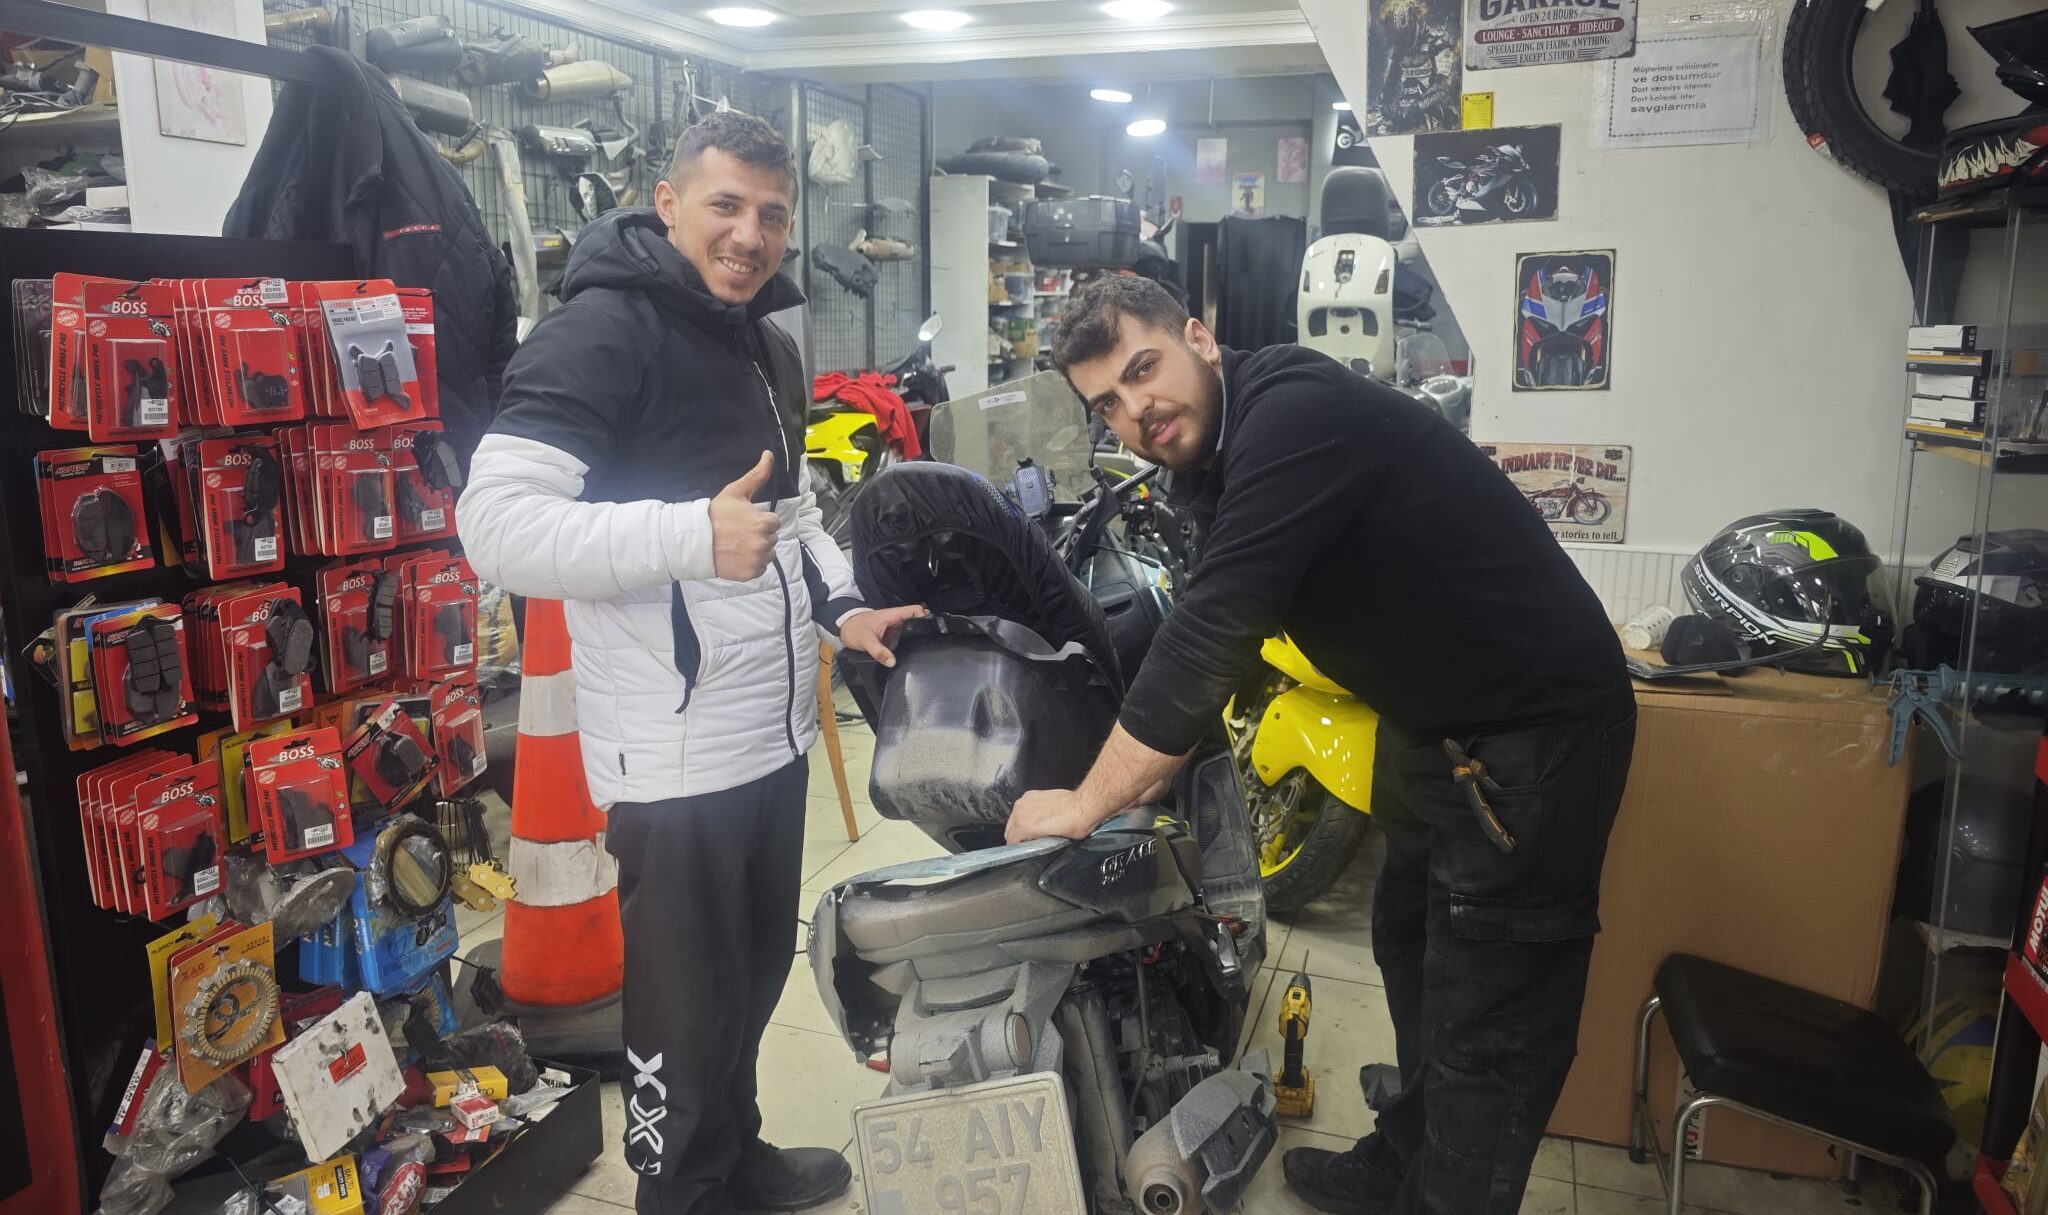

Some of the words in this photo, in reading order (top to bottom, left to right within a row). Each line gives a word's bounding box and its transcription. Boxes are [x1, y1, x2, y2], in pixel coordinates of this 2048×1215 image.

[1519, 13, 1540, 24] OPEN
[1541, 12, 1551, 21] 24
[1552, 10, 1579, 21] HOURS
[1482, 29, 1515, 42] LOUNGE
[1521, 24, 1571, 39] SANCTUARY
[1578, 20, 1616, 34] HIDEOUT
[1487, 41, 1535, 55] SPECIALIZING
[1536, 41, 1545, 51] IN
[1546, 38, 1570, 50] FIXING
[1572, 35, 1610, 48] ANYTHING
[1519, 52, 1547, 63] EXCEPT
[1549, 50, 1576, 61] STUPID
[1652, 71, 1722, 82] dostumdur
[111, 301, 148, 314] BOSS
[58, 333, 66, 346] PAD
[58, 371, 66, 411] MOTORCYCLE
[225, 370, 235, 408] MOTORCYCLE
[350, 438, 374, 450] BOSS
[1501, 452, 1553, 474] INDIANS
[1554, 452, 1594, 476] NEVER
[1560, 528, 1589, 540] stories
[1592, 531, 1601, 540] to
[1603, 531, 1619, 541] tell.
[214, 528, 222, 564] MOTORCYCLE
[343, 576, 365, 591] BOSS
[435, 571, 460, 583] BOSS
[1694, 563, 1776, 646] SCORPION
[252, 609, 269, 622] BO
[445, 688, 464, 706] BOSS
[279, 745, 315, 762] BOSS
[161, 782, 194, 803] BOSS
[268, 820, 279, 850] MOTORCYCLE
[151, 870, 161, 905] MOTORCYCLE
[869, 1113, 933, 1174] 54
[965, 1096, 1046, 1163] AIY
[935, 1162, 1031, 1215] 957
